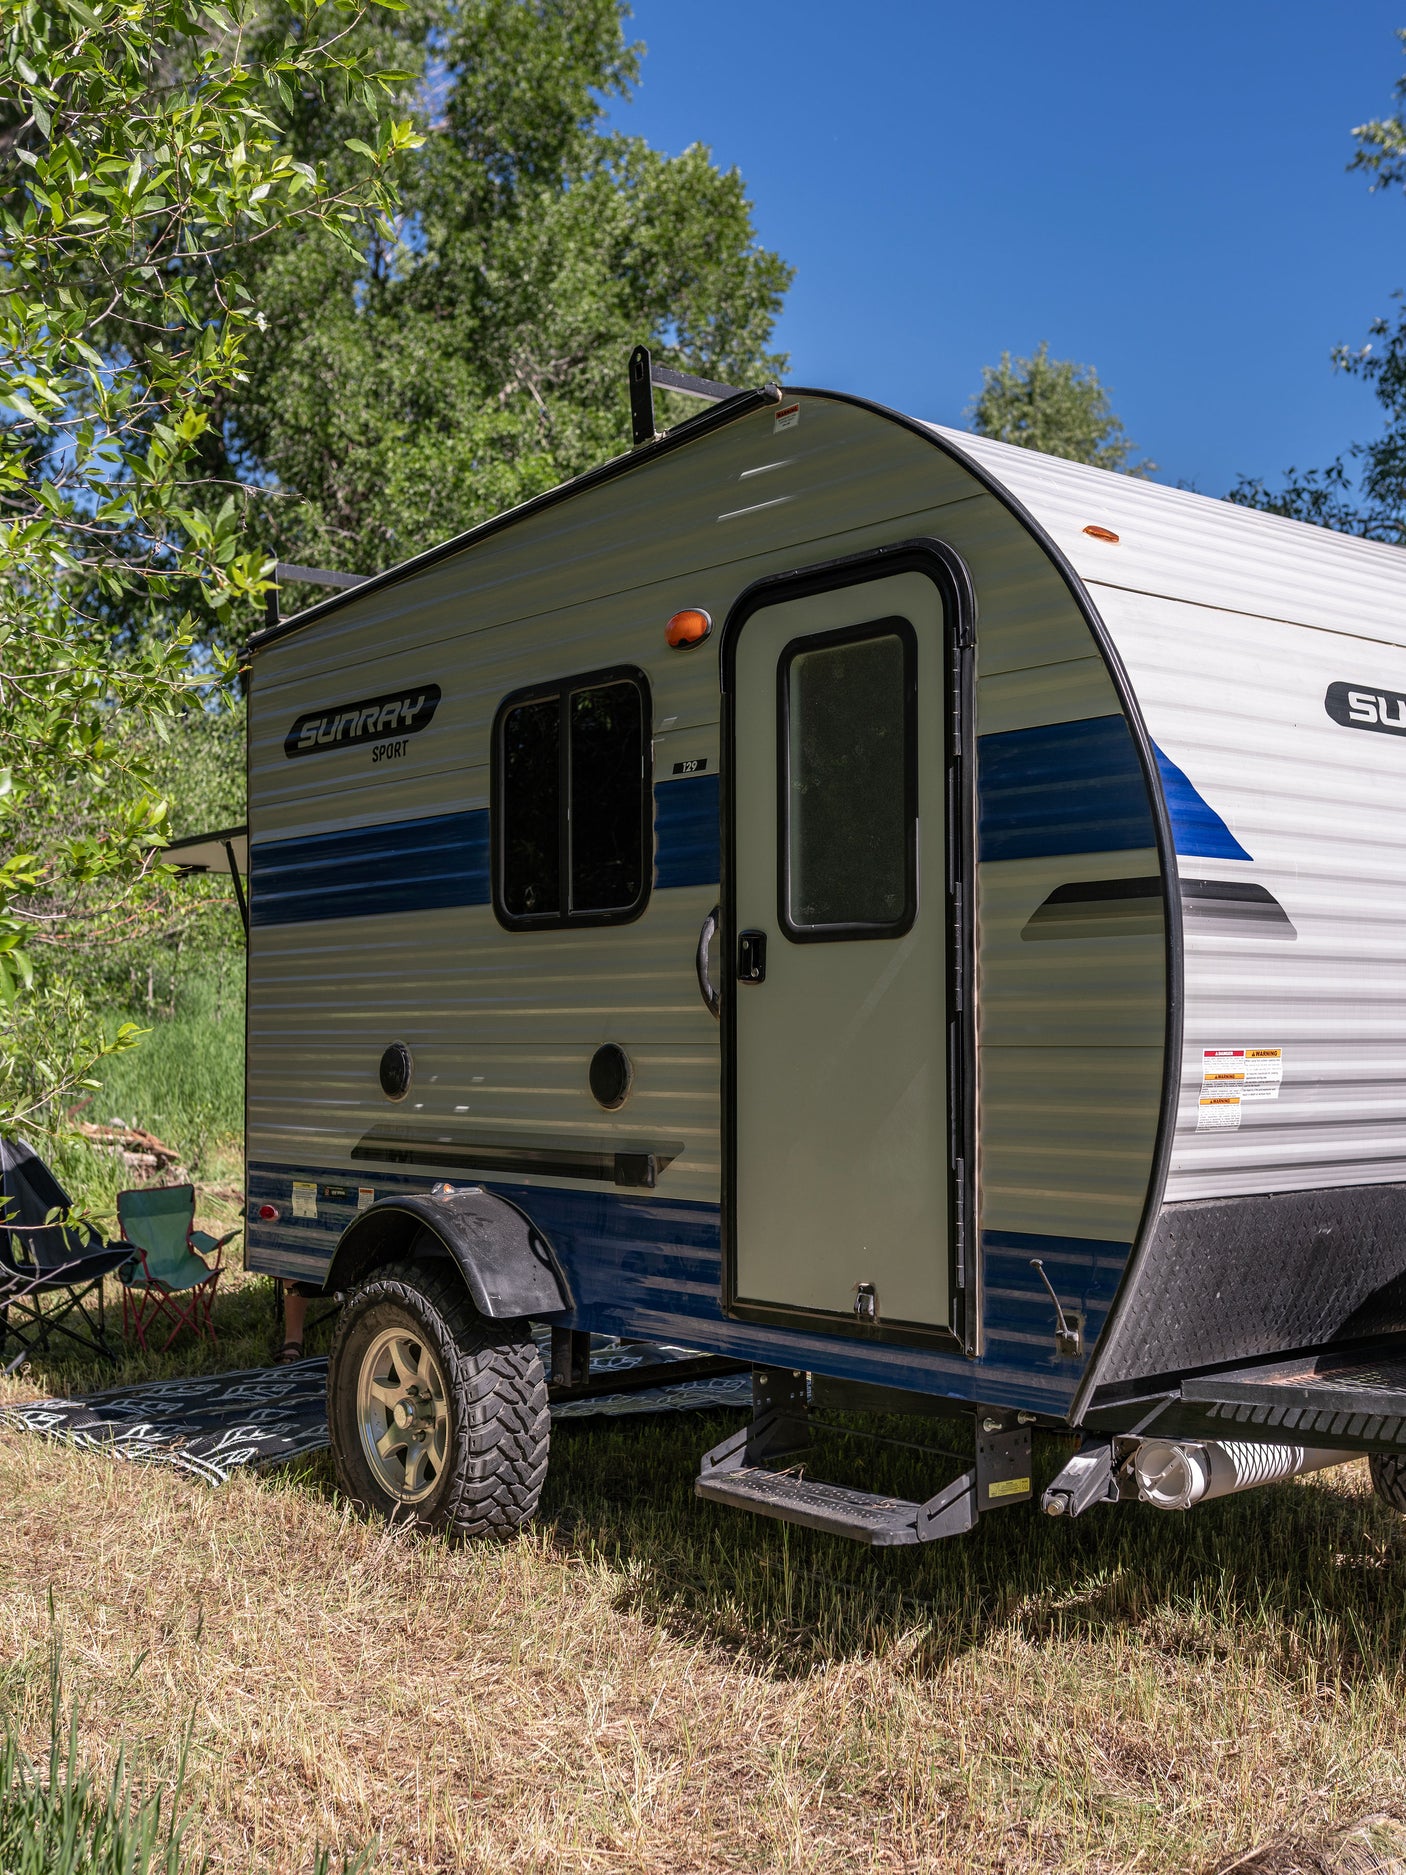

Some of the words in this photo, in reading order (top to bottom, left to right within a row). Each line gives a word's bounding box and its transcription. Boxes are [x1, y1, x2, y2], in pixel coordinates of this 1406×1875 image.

[297, 696, 426, 748] SUNRAY
[372, 739, 409, 763] SPORT
[682, 760, 698, 773] 129
